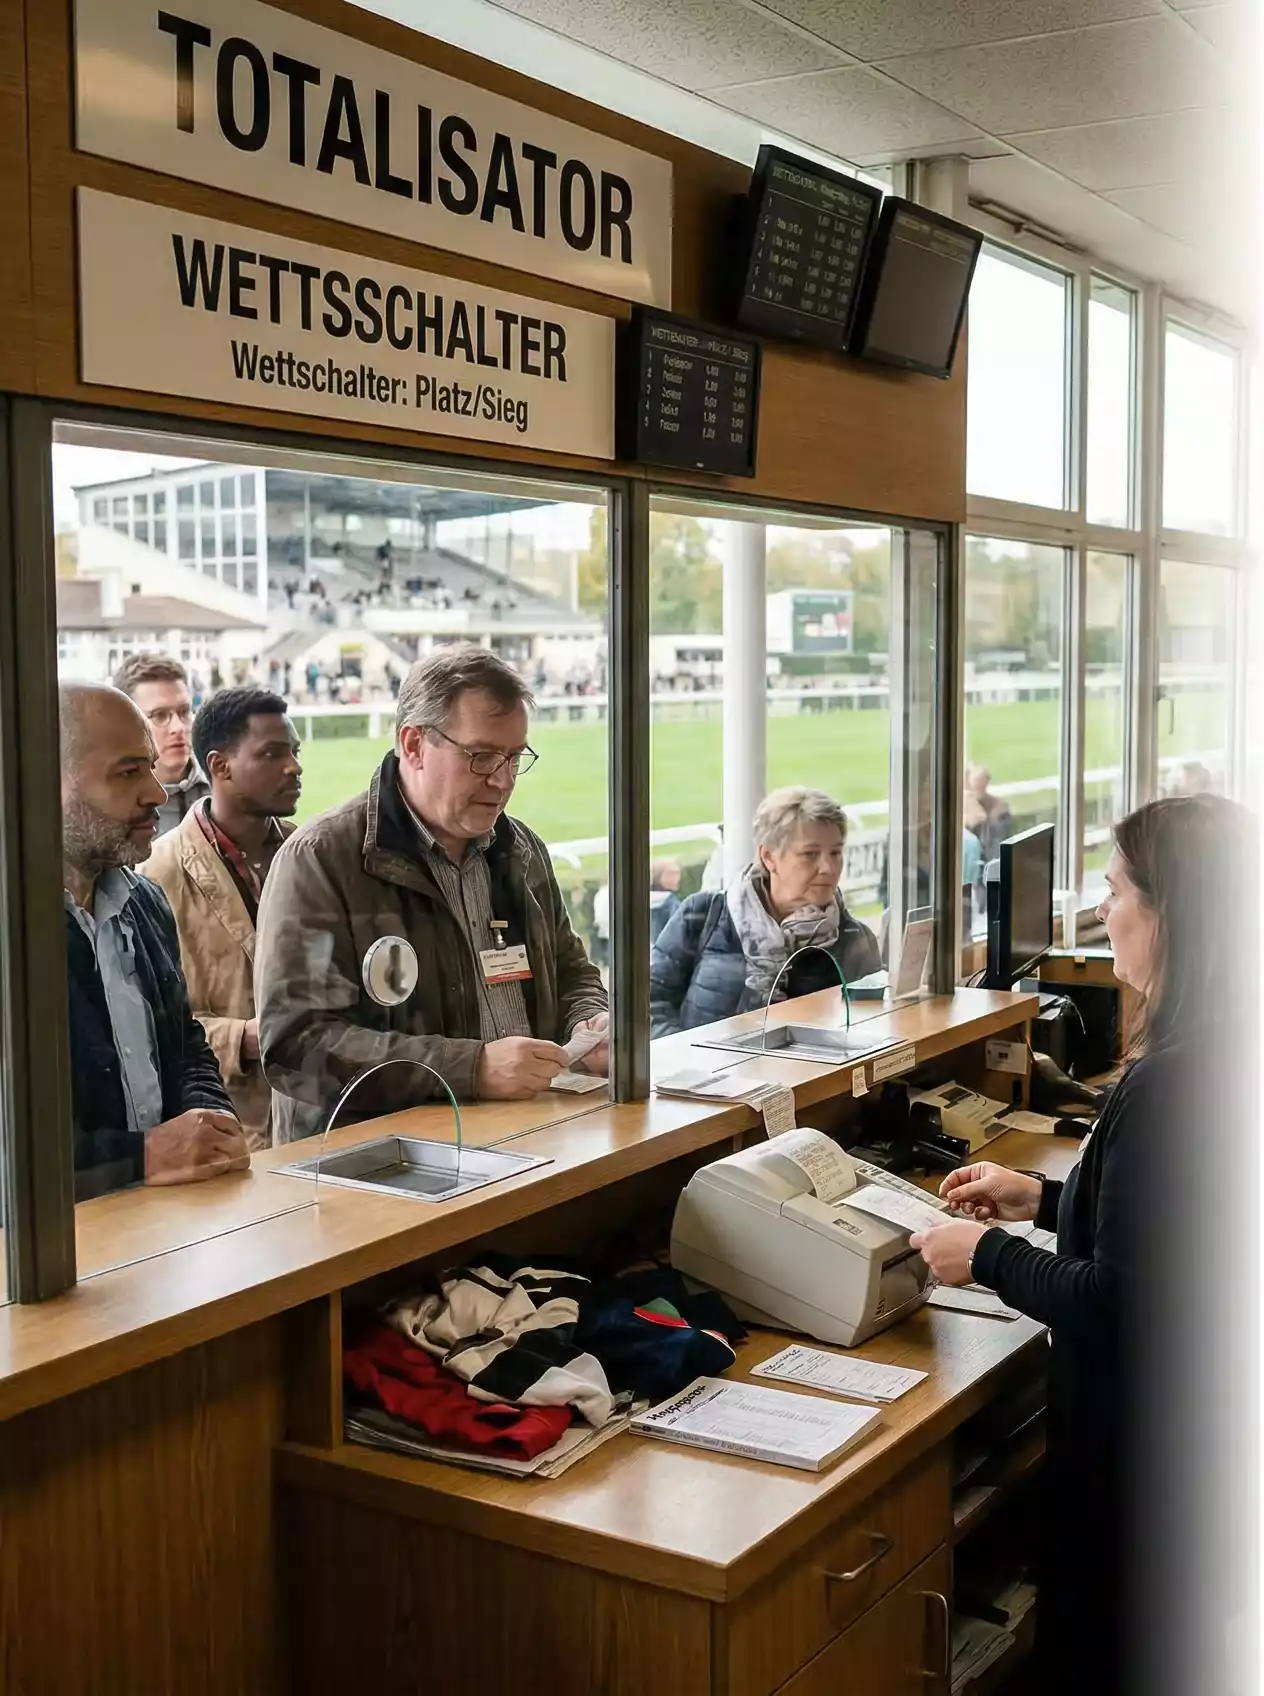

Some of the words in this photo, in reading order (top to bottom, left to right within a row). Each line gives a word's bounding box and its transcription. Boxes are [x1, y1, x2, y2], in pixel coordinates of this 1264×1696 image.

[158, 10, 634, 265] TOTALISATOR
[171, 233, 568, 383] WETTSSCHALTER
[231, 340, 408, 406] Wettschalter:
[415, 373, 530, 433] Platz/Sieg
